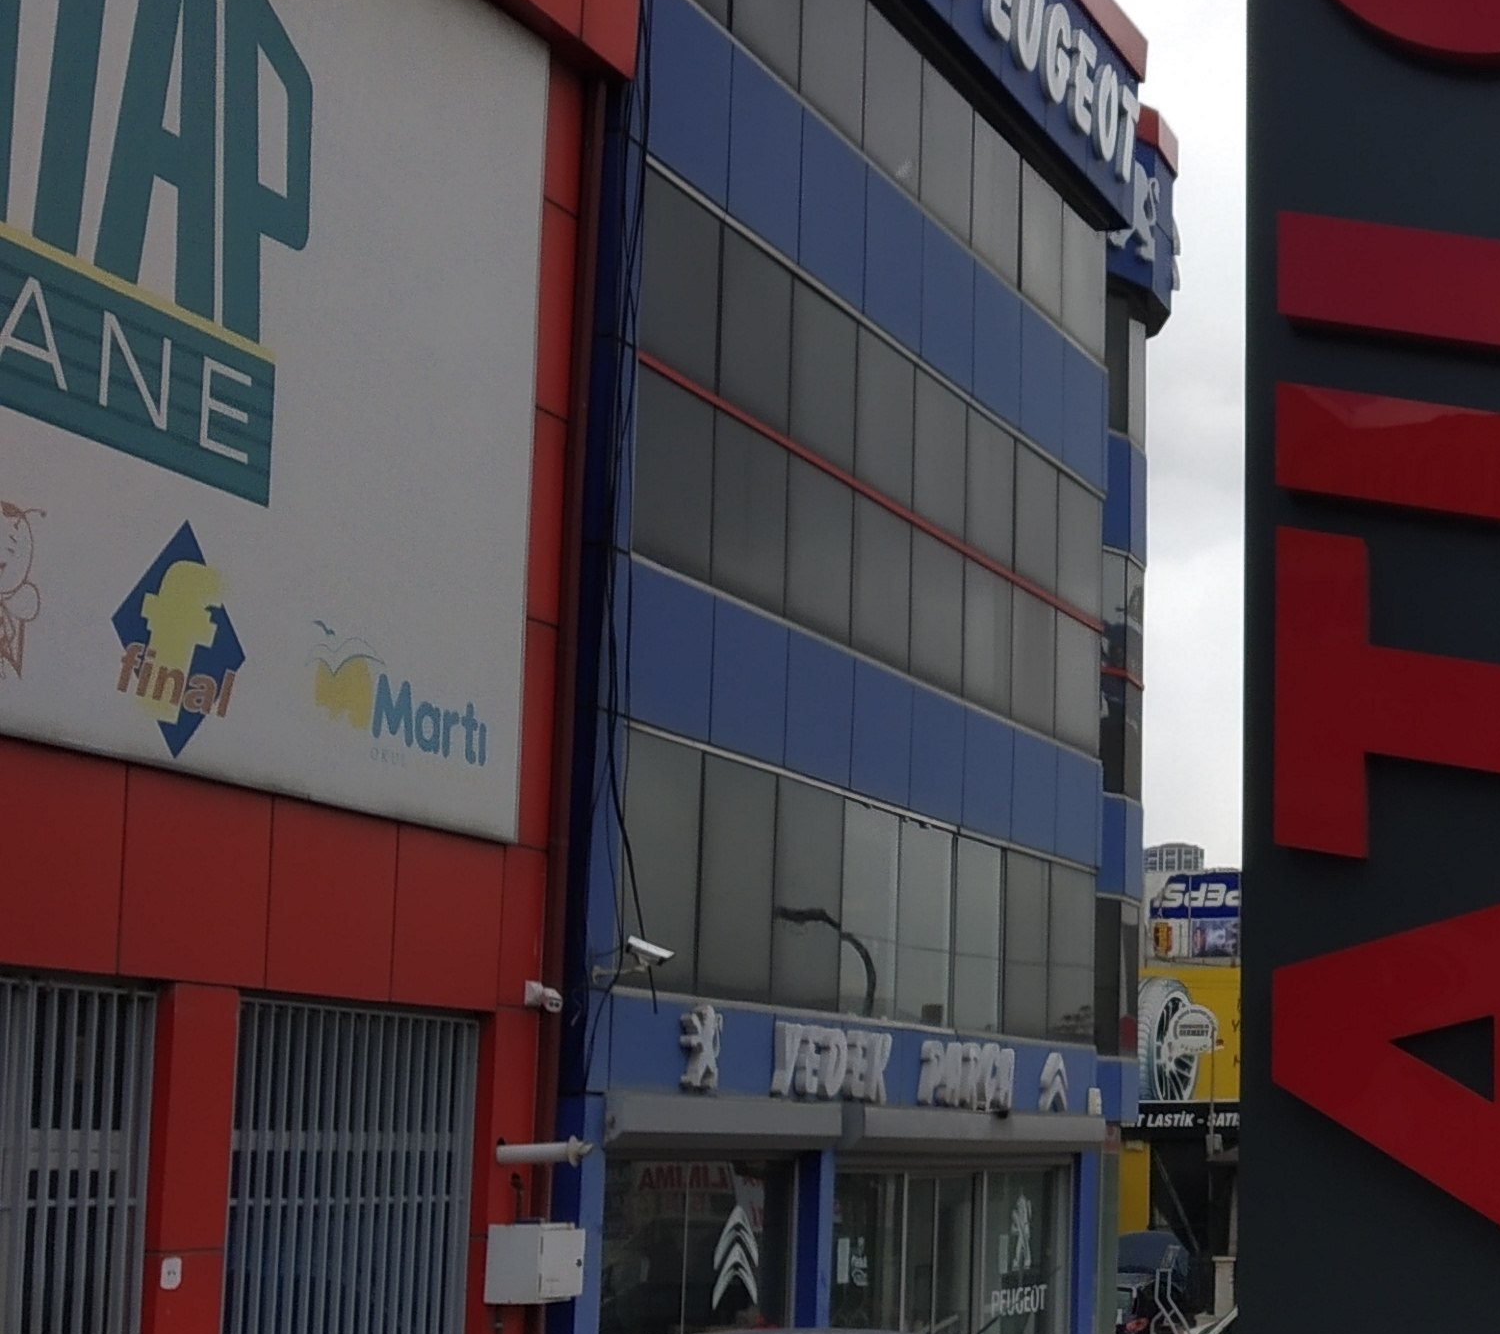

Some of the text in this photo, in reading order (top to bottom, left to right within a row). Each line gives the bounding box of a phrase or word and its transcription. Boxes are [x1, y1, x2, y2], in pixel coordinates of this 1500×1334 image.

[116, 642, 237, 719] final
[1146, 1109, 1196, 1128] LASTİK
[990, 1284, 1048, 1318] PEUGEOT
